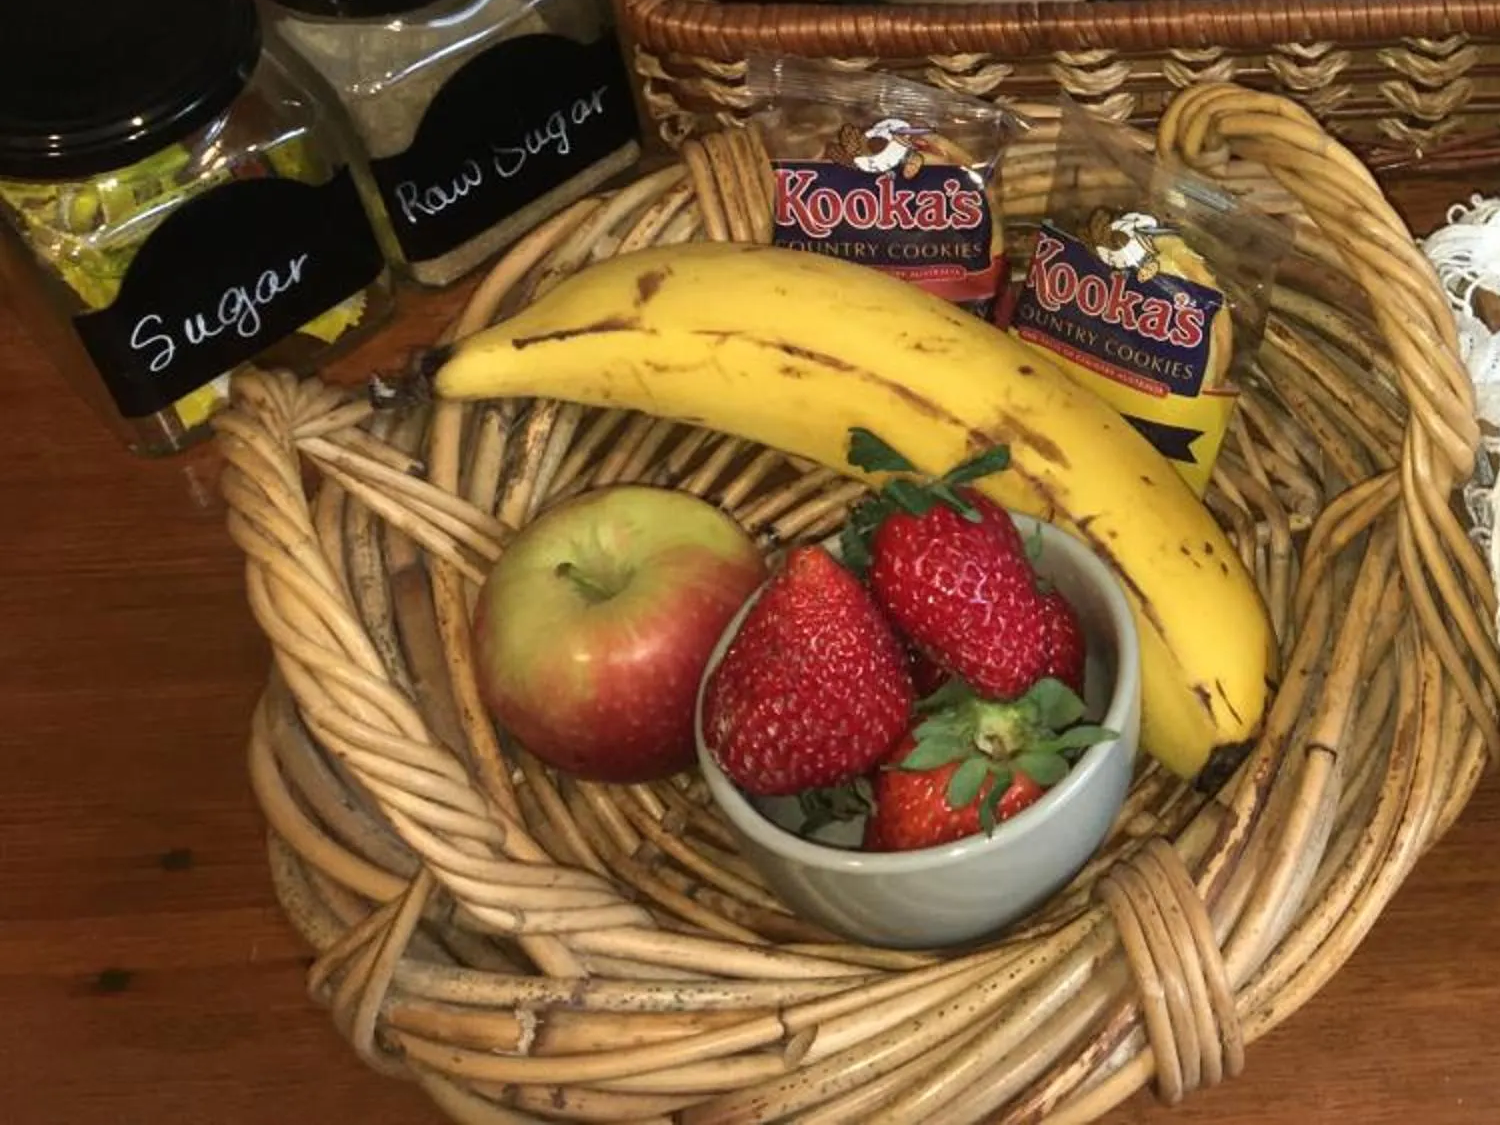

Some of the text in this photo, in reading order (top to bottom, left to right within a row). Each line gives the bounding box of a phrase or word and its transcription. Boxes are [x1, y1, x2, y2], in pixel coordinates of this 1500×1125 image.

[395, 83, 609, 224] Raw Sugar
[774, 168, 984, 239] Kooka's
[887, 241, 983, 260] COOKIES
[129, 251, 310, 373] Sugar
[1027, 231, 1206, 348] Kooka's
[1019, 304, 1194, 380] OUNTRY COOKIES
